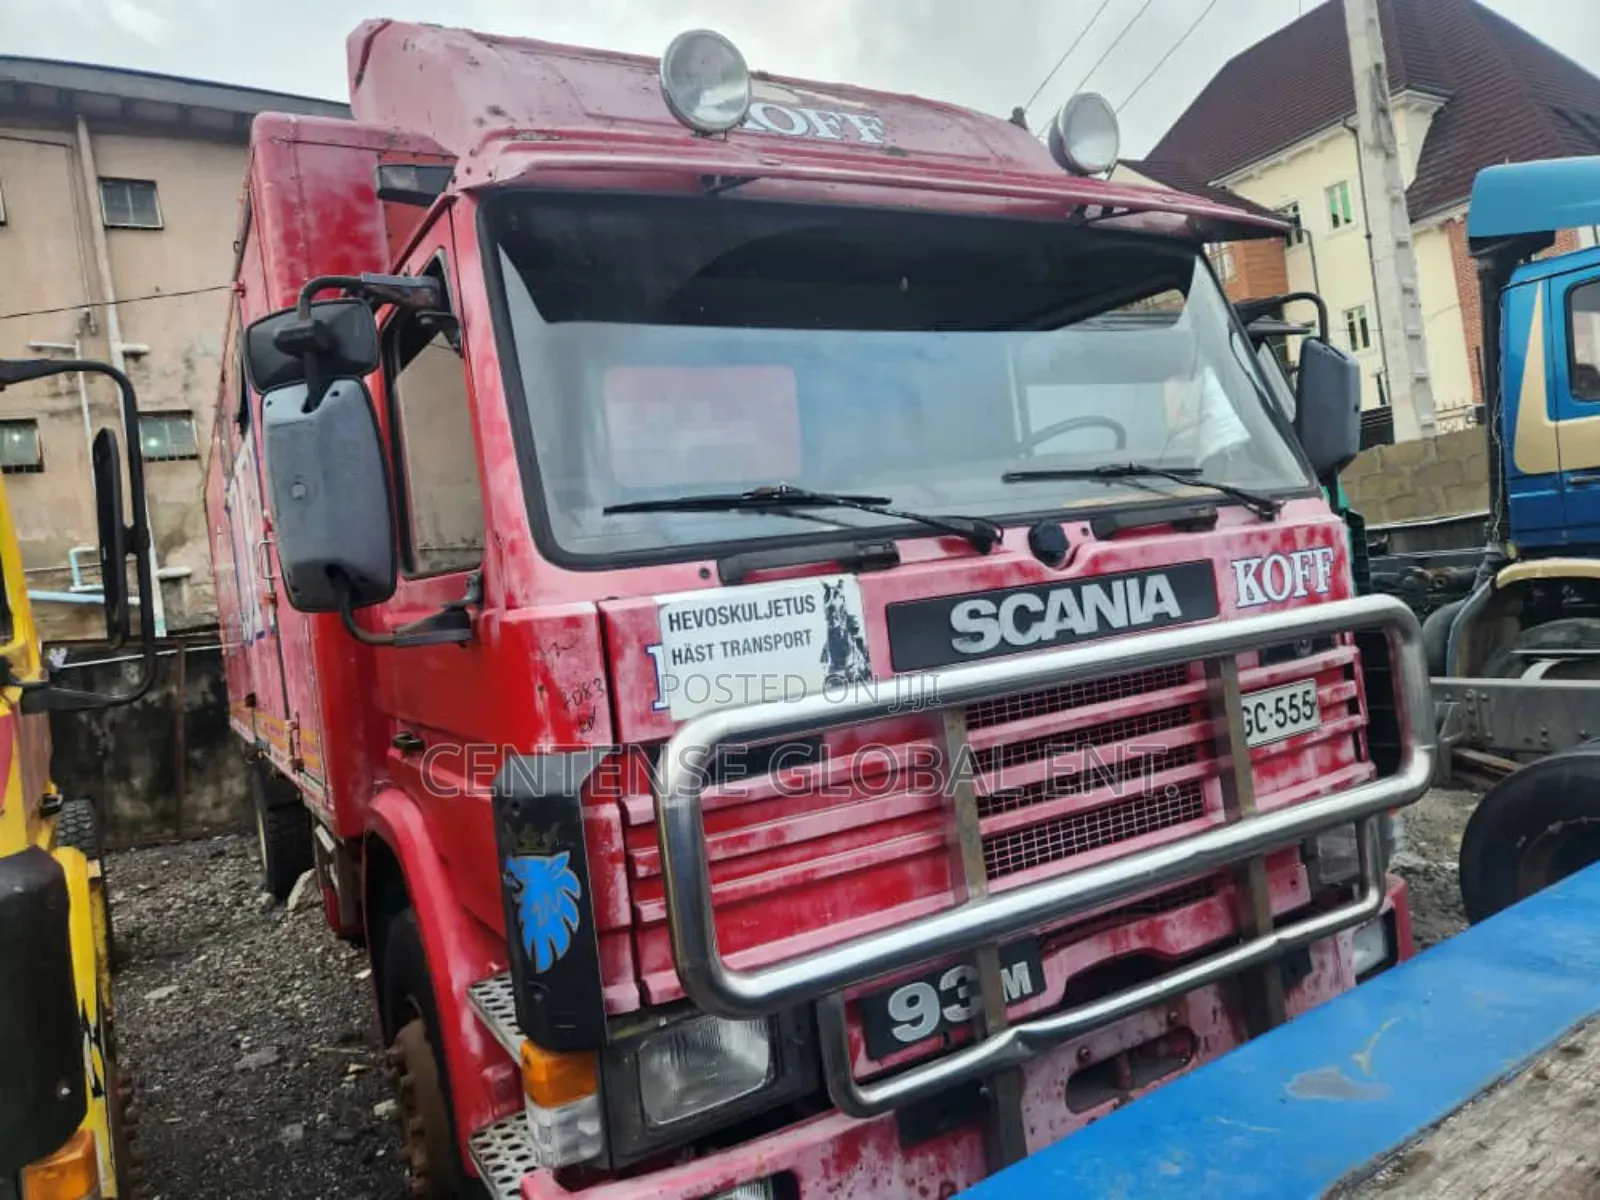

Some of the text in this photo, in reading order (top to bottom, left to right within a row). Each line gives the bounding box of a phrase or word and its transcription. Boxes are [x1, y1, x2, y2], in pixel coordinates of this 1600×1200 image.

[740, 102, 884, 144] OFF
[1231, 547, 1334, 608] KOFF
[668, 595, 816, 632] HEVOSKULJETUS
[949, 573, 1183, 655] SCANIA
[671, 629, 812, 666] HÄST TRANSPORT
